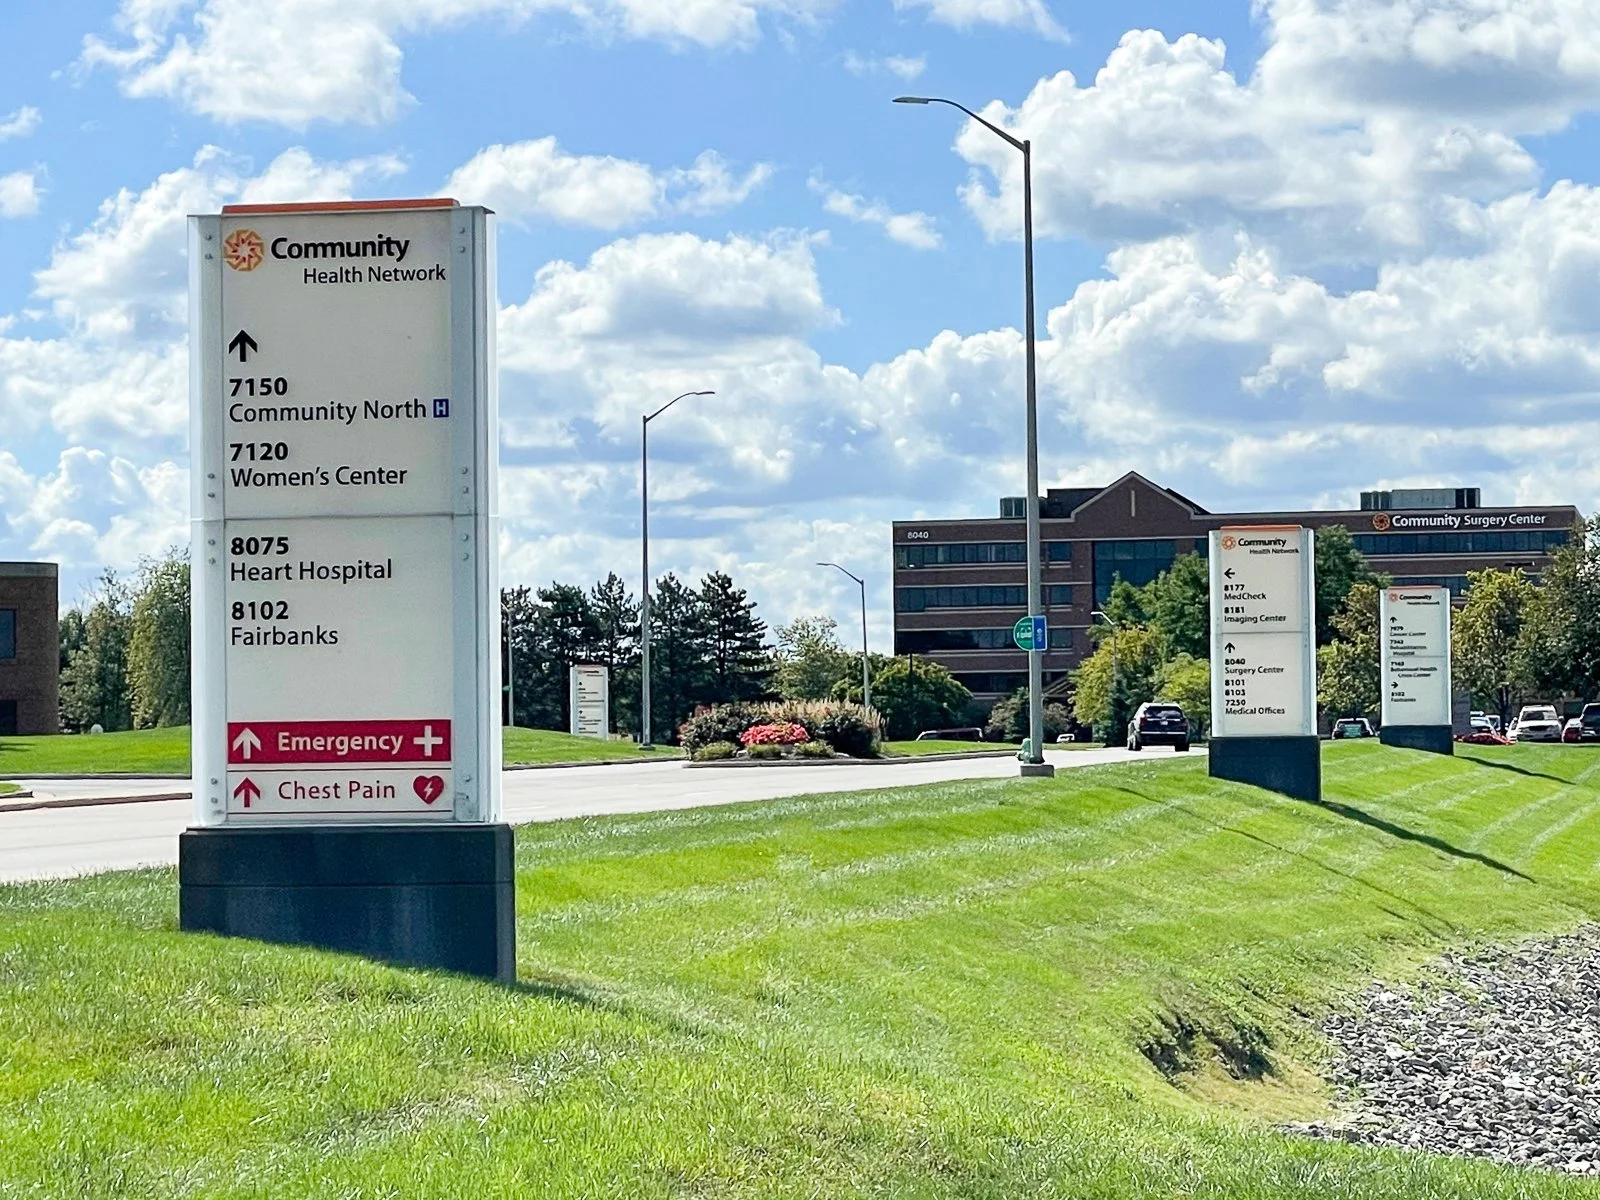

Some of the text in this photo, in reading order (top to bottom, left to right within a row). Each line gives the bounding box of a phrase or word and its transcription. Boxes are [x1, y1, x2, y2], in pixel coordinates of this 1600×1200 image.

[271, 234, 409, 262] Community
[304, 264, 446, 284] Health Network
[229, 377, 288, 396] 7150
[229, 401, 357, 424] Community
[364, 399, 426, 419] North
[230, 442, 288, 461] 7120
[231, 466, 407, 487] Women's Center
[1392, 514, 1546, 528] Community Surgery Center
[907, 531, 928, 539] 8040
[1238, 538, 1286, 547] Community
[230, 536, 289, 556] 8075
[230, 559, 392, 584] Heart Hospital
[231, 600, 288, 620] 8102
[1224, 616, 1257, 624] Imaging
[231, 626, 338, 646] Fairbanks
[1225, 667, 1256, 675] Surgery
[278, 732, 403, 754] Emergency
[278, 780, 395, 800] Chest Pain
